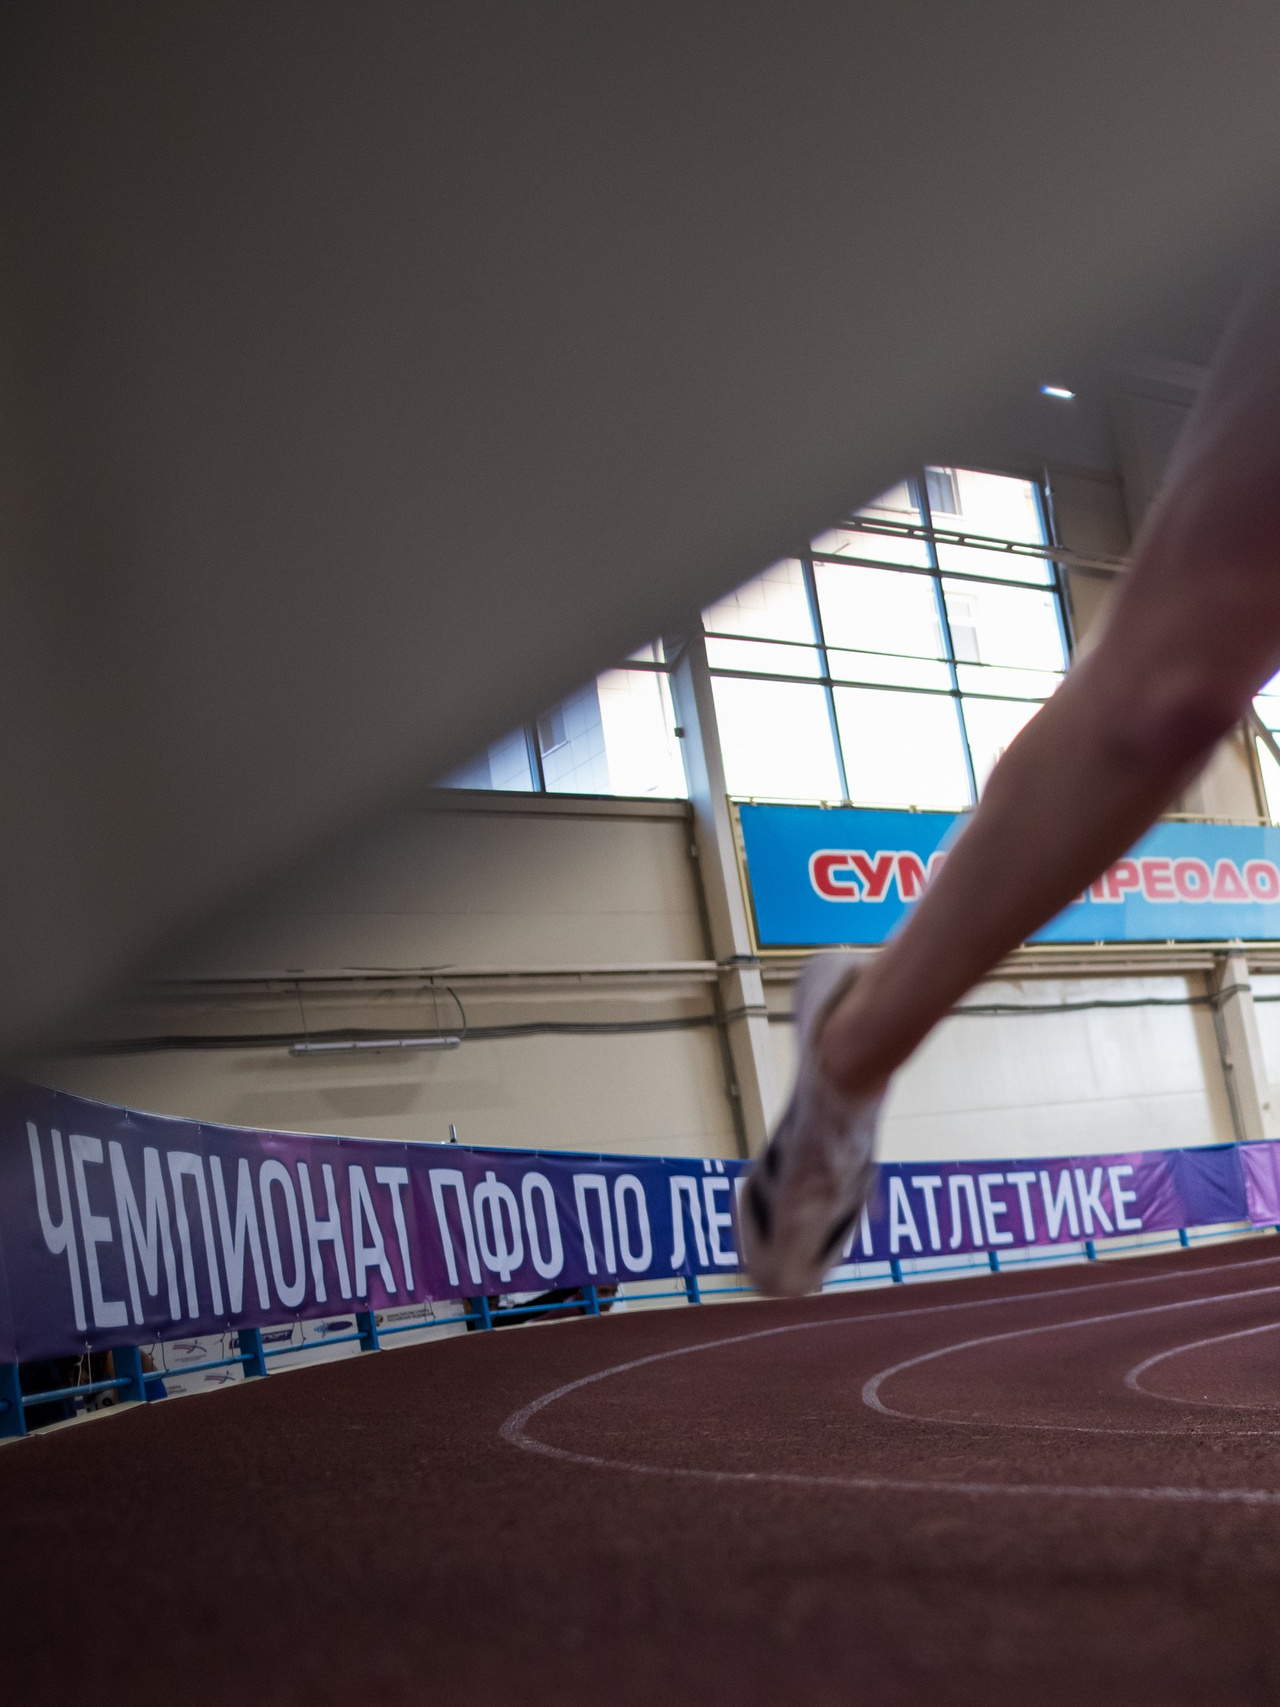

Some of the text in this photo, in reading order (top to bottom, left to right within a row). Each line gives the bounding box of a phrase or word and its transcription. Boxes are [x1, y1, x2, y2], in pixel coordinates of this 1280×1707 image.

[26, 1121, 415, 1331] ЧЕМПИОНАТ
[428, 1168, 565, 1287] ПФО
[573, 1173, 653, 1275] ПО
[889, 1164, 1143, 1254] АТЛЕТИКЕ
